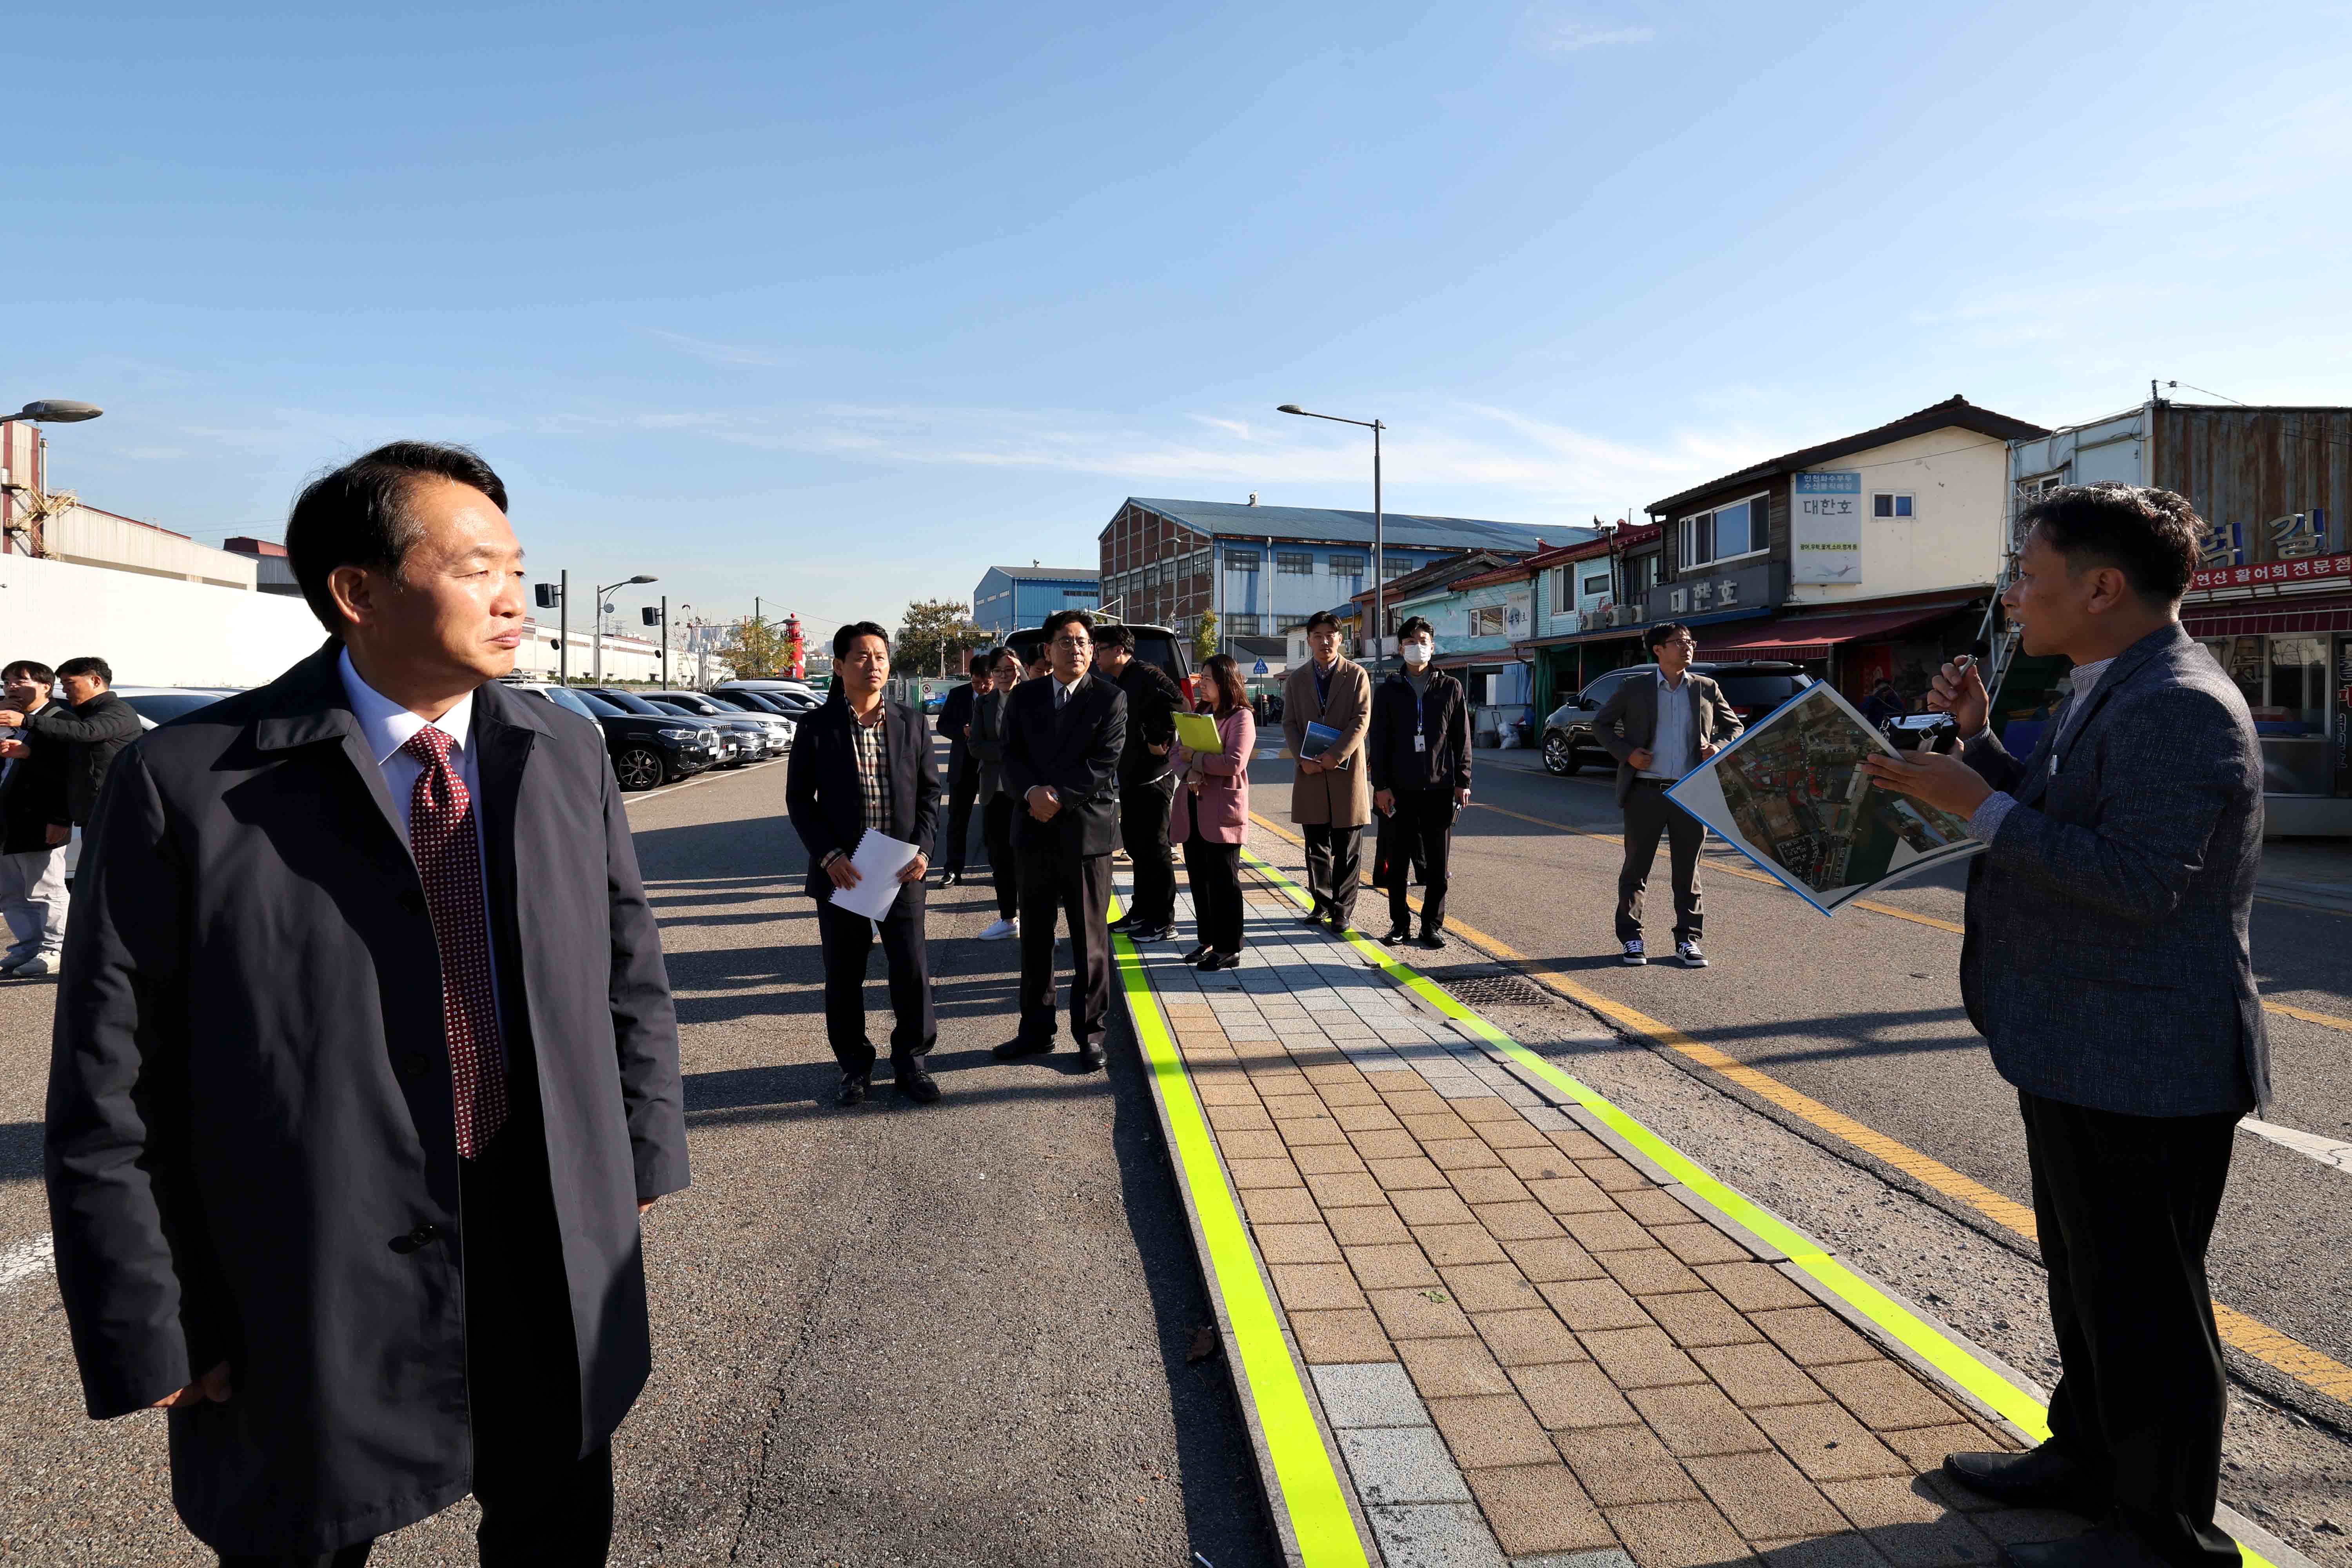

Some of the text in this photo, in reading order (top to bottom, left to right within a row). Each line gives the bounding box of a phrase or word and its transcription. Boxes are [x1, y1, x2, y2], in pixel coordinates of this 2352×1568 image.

[1803, 498, 1853, 515] 대한호
[2193, 571, 2228, 587] 연산
[1670, 580, 1738, 613] 대한호
